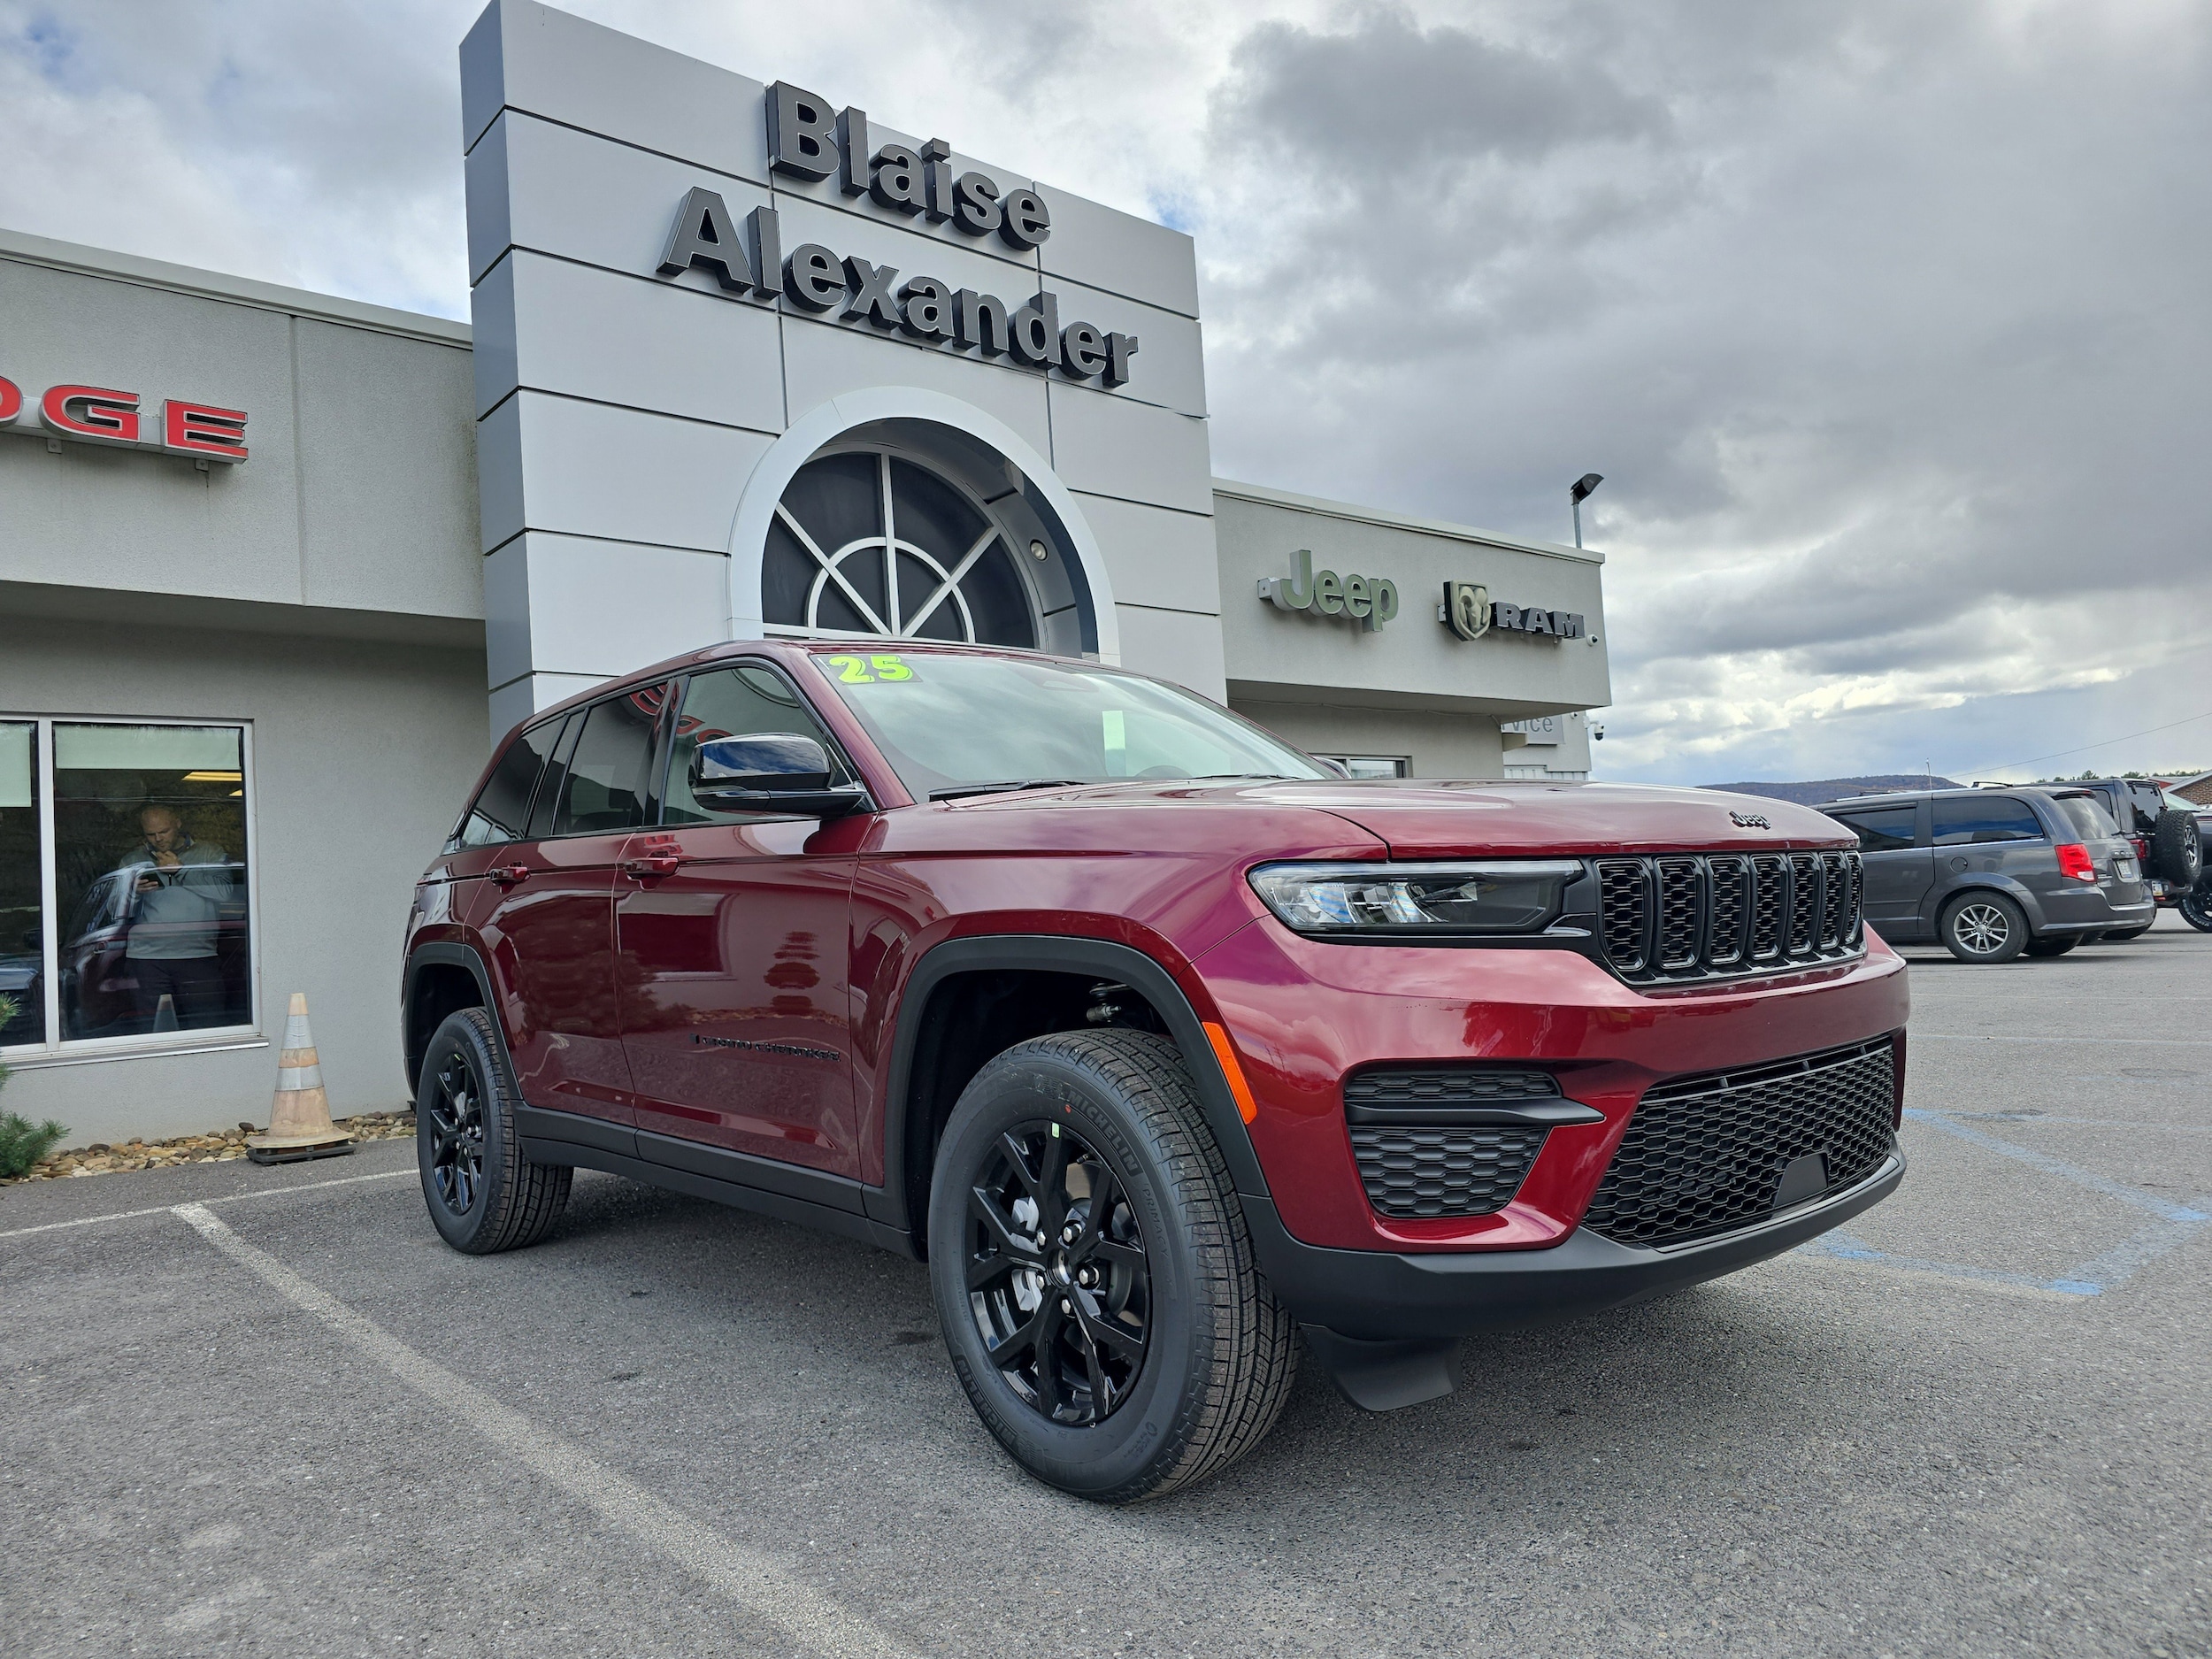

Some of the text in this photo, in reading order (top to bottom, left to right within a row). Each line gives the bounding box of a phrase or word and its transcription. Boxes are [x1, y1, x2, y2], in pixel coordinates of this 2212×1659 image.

[766, 80, 1050, 251] Blaise
[657, 187, 1138, 388] Alexander
[0, 375, 249, 464] GE
[1271, 549, 1399, 633] Jeep
[1490, 602, 1586, 640] RAM
[829, 655, 913, 684] 25
[1729, 810, 1770, 830] Jeep
[1066, 1089, 1140, 1172] MICHELIN
